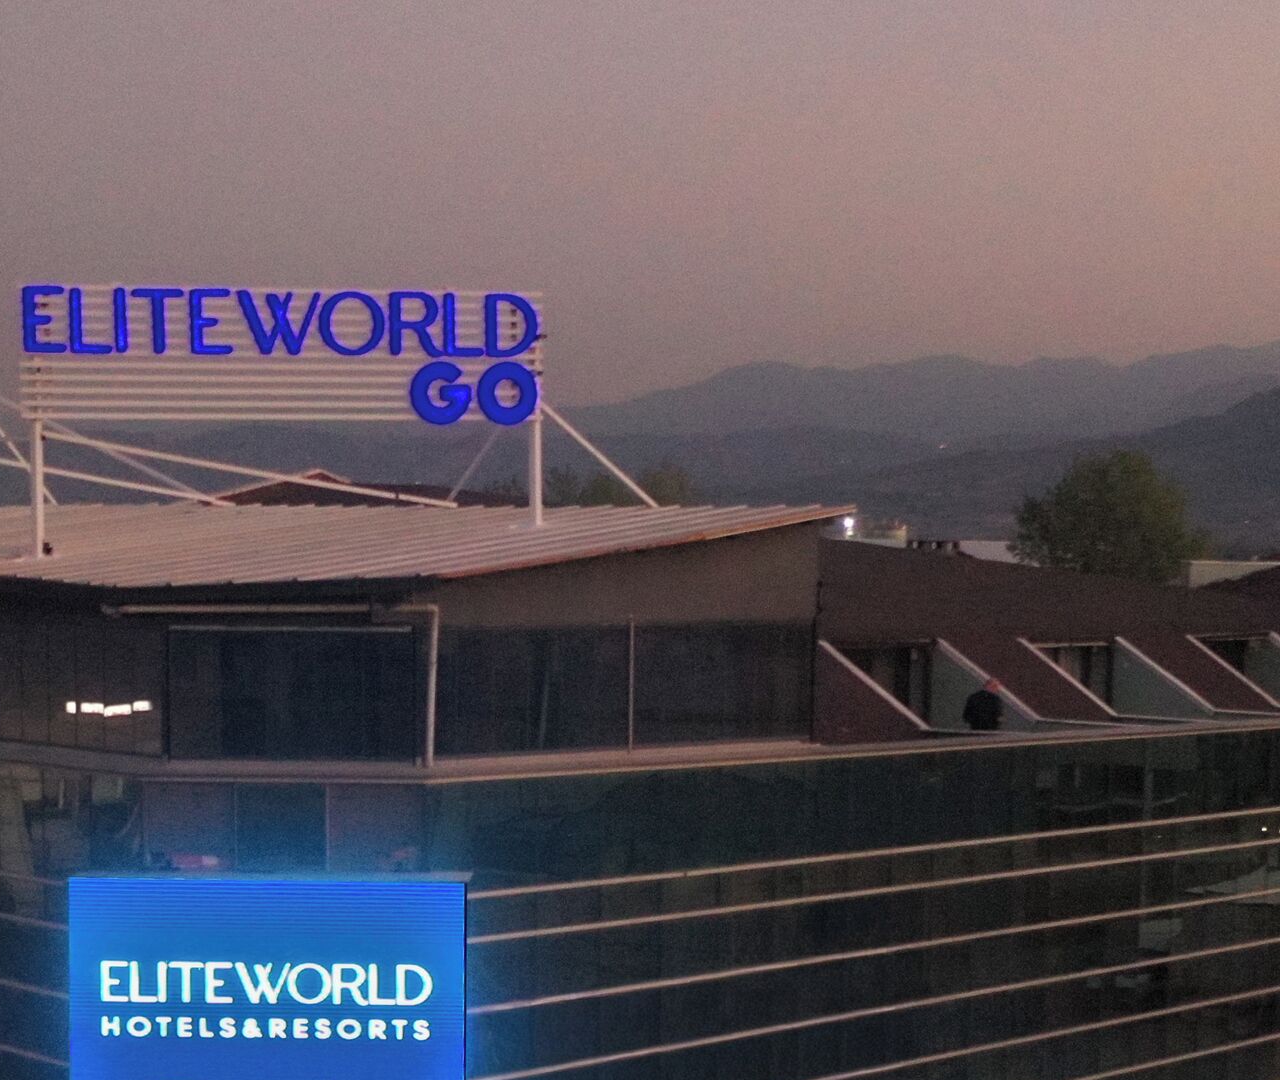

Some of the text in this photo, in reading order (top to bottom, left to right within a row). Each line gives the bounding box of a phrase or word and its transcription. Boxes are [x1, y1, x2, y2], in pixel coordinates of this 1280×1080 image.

[20, 283, 541, 358] ELITEWORLD
[409, 360, 540, 427] GO
[99, 959, 433, 1006] ELITEWORLD
[100, 1014, 431, 1041] HOTELS&RESORTS
